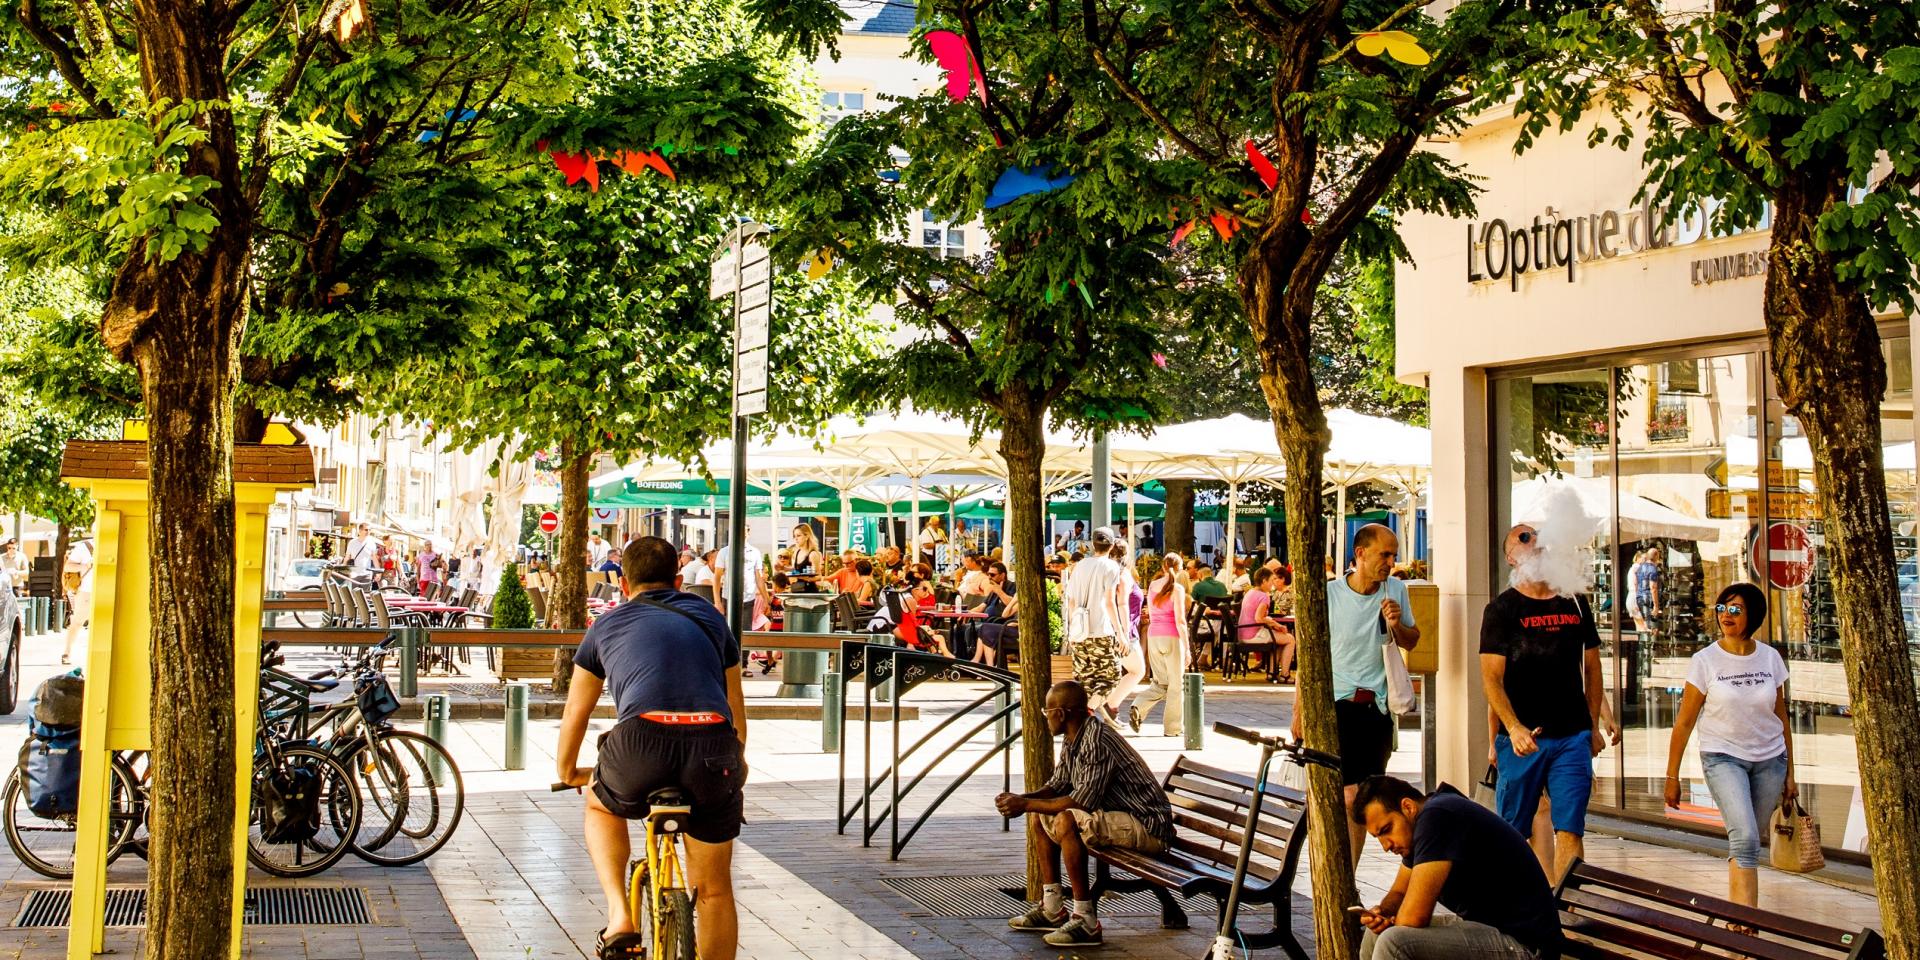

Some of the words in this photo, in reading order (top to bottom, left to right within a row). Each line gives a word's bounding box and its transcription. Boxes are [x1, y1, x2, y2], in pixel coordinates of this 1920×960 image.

[1468, 206, 1620, 292] L'Optique
[1628, 191, 1670, 252] du
[637, 481, 683, 490] BOFFERDING
